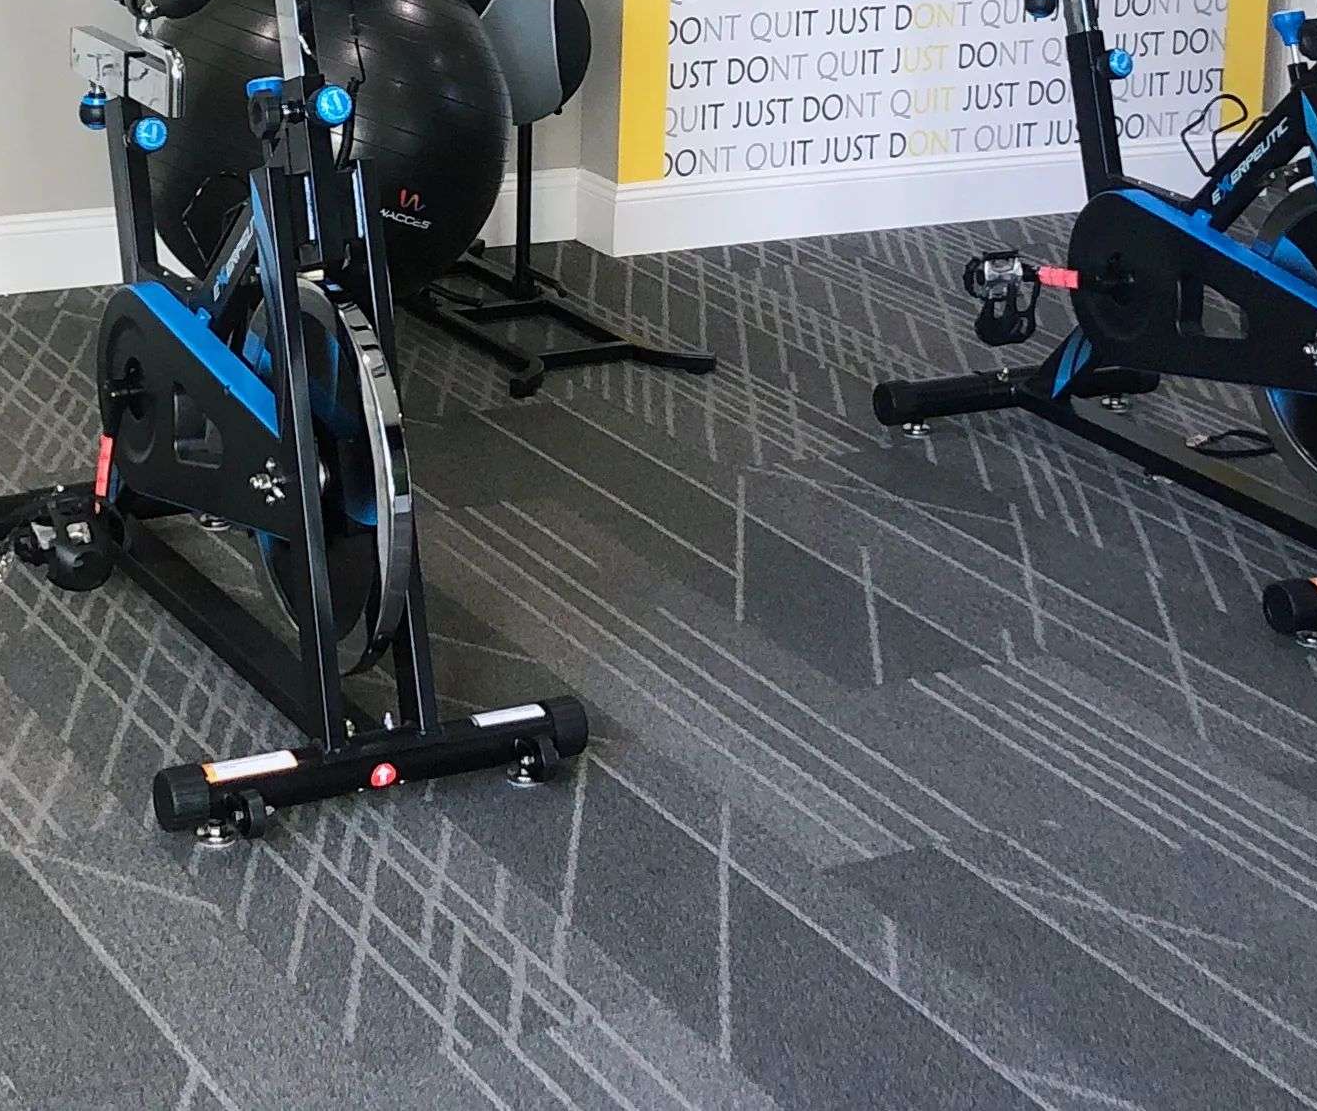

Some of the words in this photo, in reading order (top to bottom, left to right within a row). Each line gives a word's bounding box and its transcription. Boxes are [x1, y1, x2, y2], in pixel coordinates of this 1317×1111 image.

[750, 10, 819, 43] QUIT
[826, 6, 886, 35] JUST
[727, 53, 809, 85] DONT
[817, 48, 885, 82] QUIT
[958, 39, 1034, 69] DONT
[732, 97, 794, 128] JUST
[802, 91, 882, 123] DONT
[962, 82, 1020, 111] JUST
